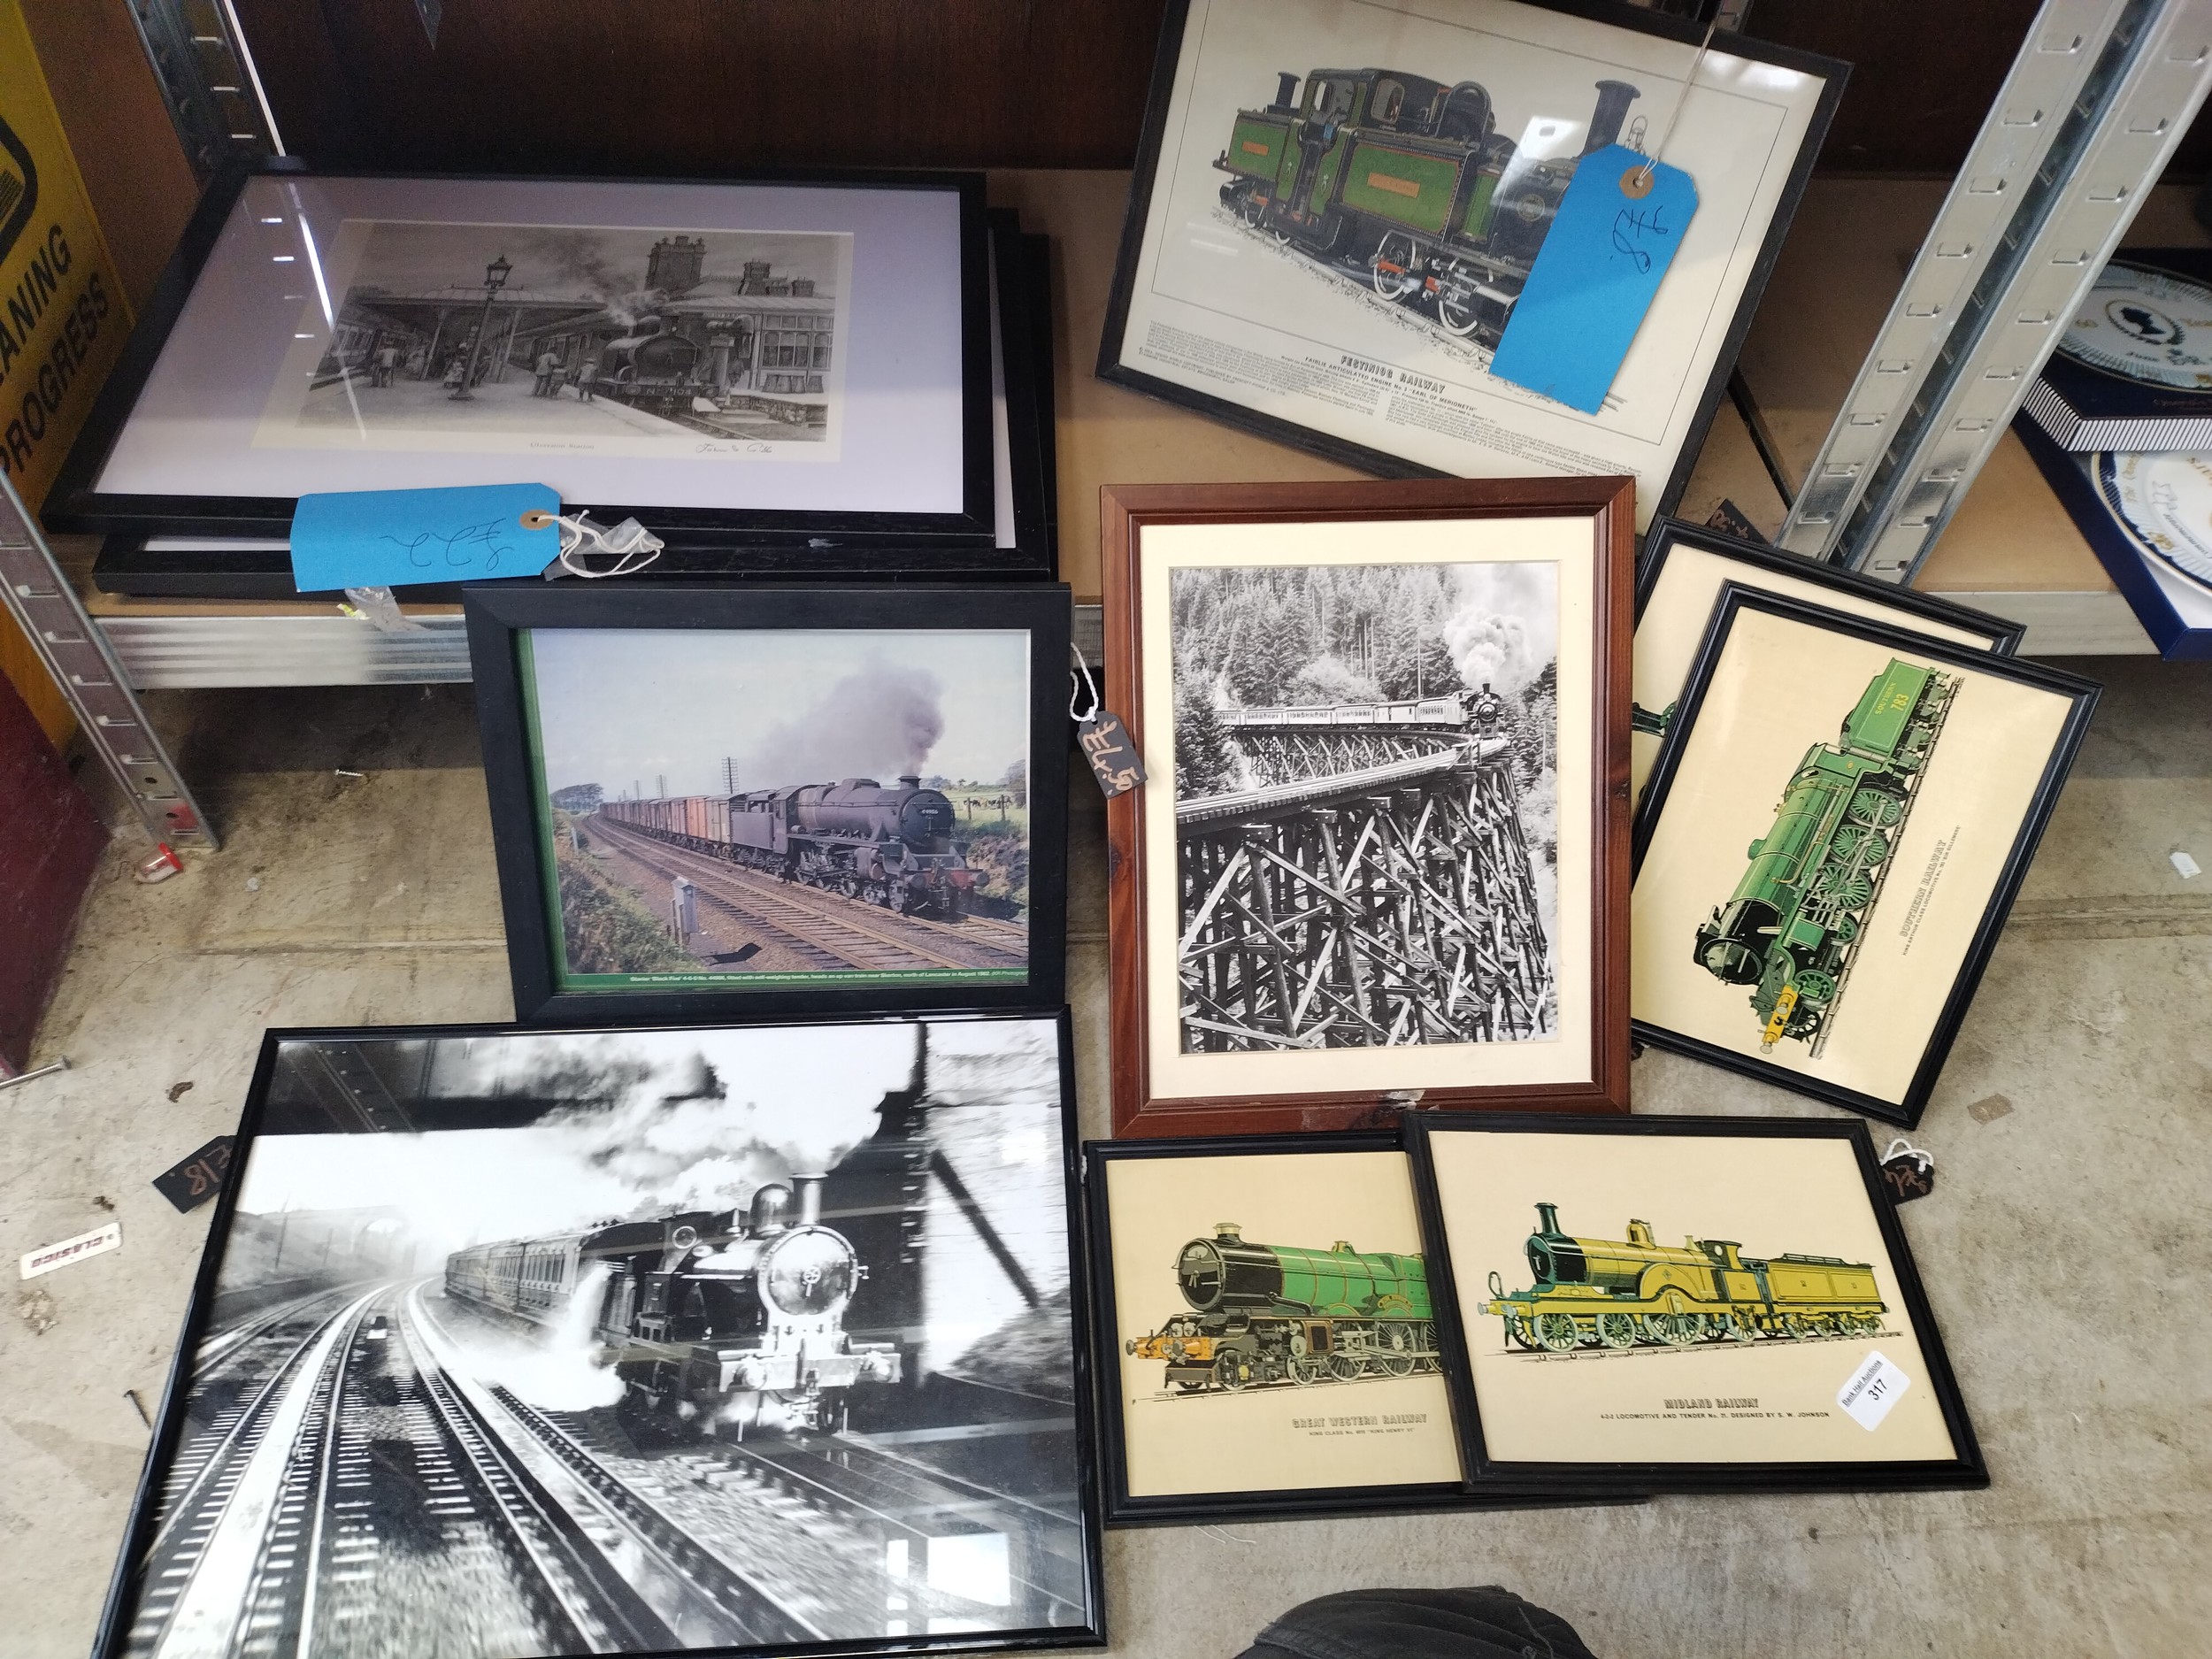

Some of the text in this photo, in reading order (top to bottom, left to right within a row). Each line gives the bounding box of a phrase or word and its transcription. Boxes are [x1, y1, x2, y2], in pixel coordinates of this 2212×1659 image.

[0, 224, 73, 386] ANING
[1340, 355, 1446, 395] FESTINIOG RAILWAY
[1891, 694, 1909, 711] 783
[1900, 839, 1947, 938] SOUTHERN RAILWAY
[1861, 1359, 1883, 1385] Auctions
[1868, 1378, 1887, 1401] 317
[1663, 1398, 1759, 1409] MIDLAND RAILWAY
[1292, 1414, 1427, 1429] GREAT WESTERN RAILWAY
